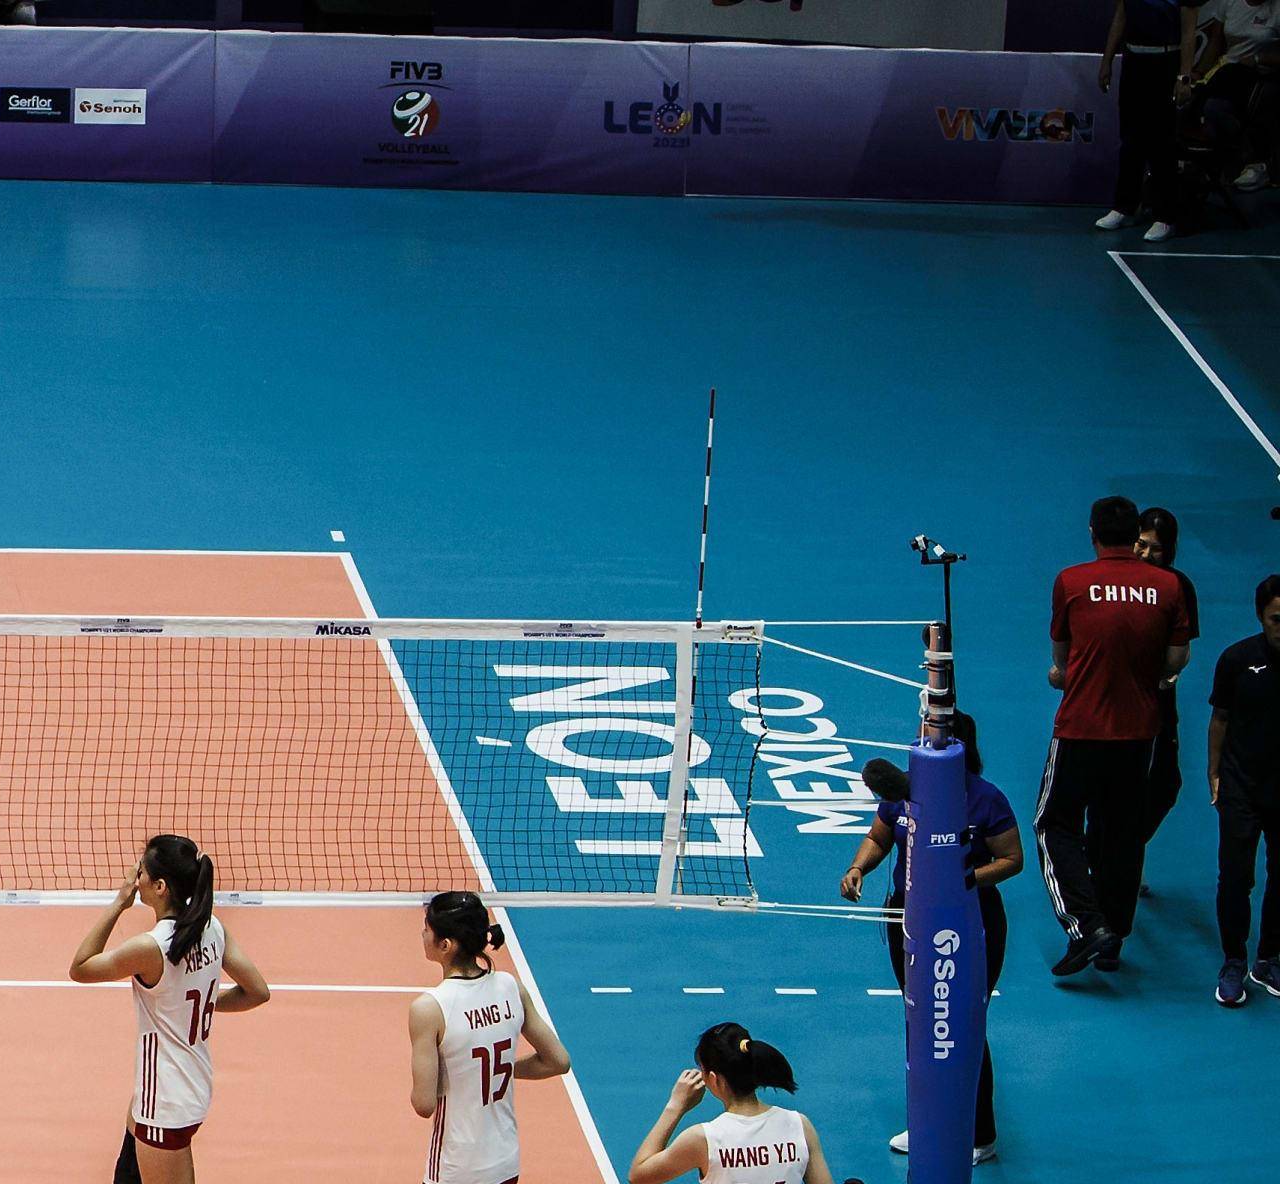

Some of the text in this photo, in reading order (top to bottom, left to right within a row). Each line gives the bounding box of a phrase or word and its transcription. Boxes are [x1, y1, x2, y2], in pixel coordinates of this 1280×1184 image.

[391, 62, 442, 79] FIVB
[8, 95, 53, 109] Gerflor
[93, 102, 142, 114] Senoh
[1089, 583, 1157, 605] CHINA
[475, 664, 765, 857] LEÓN
[728, 687, 881, 835] MEXICO
[930, 833, 956, 844] FIVB
[186, 979, 216, 1046] 16
[464, 1001, 515, 1031] YANG J.
[934, 959, 954, 1060] Senoh
[472, 1038, 512, 1107] 15
[719, 1142, 800, 1168] WANG Y.D.
